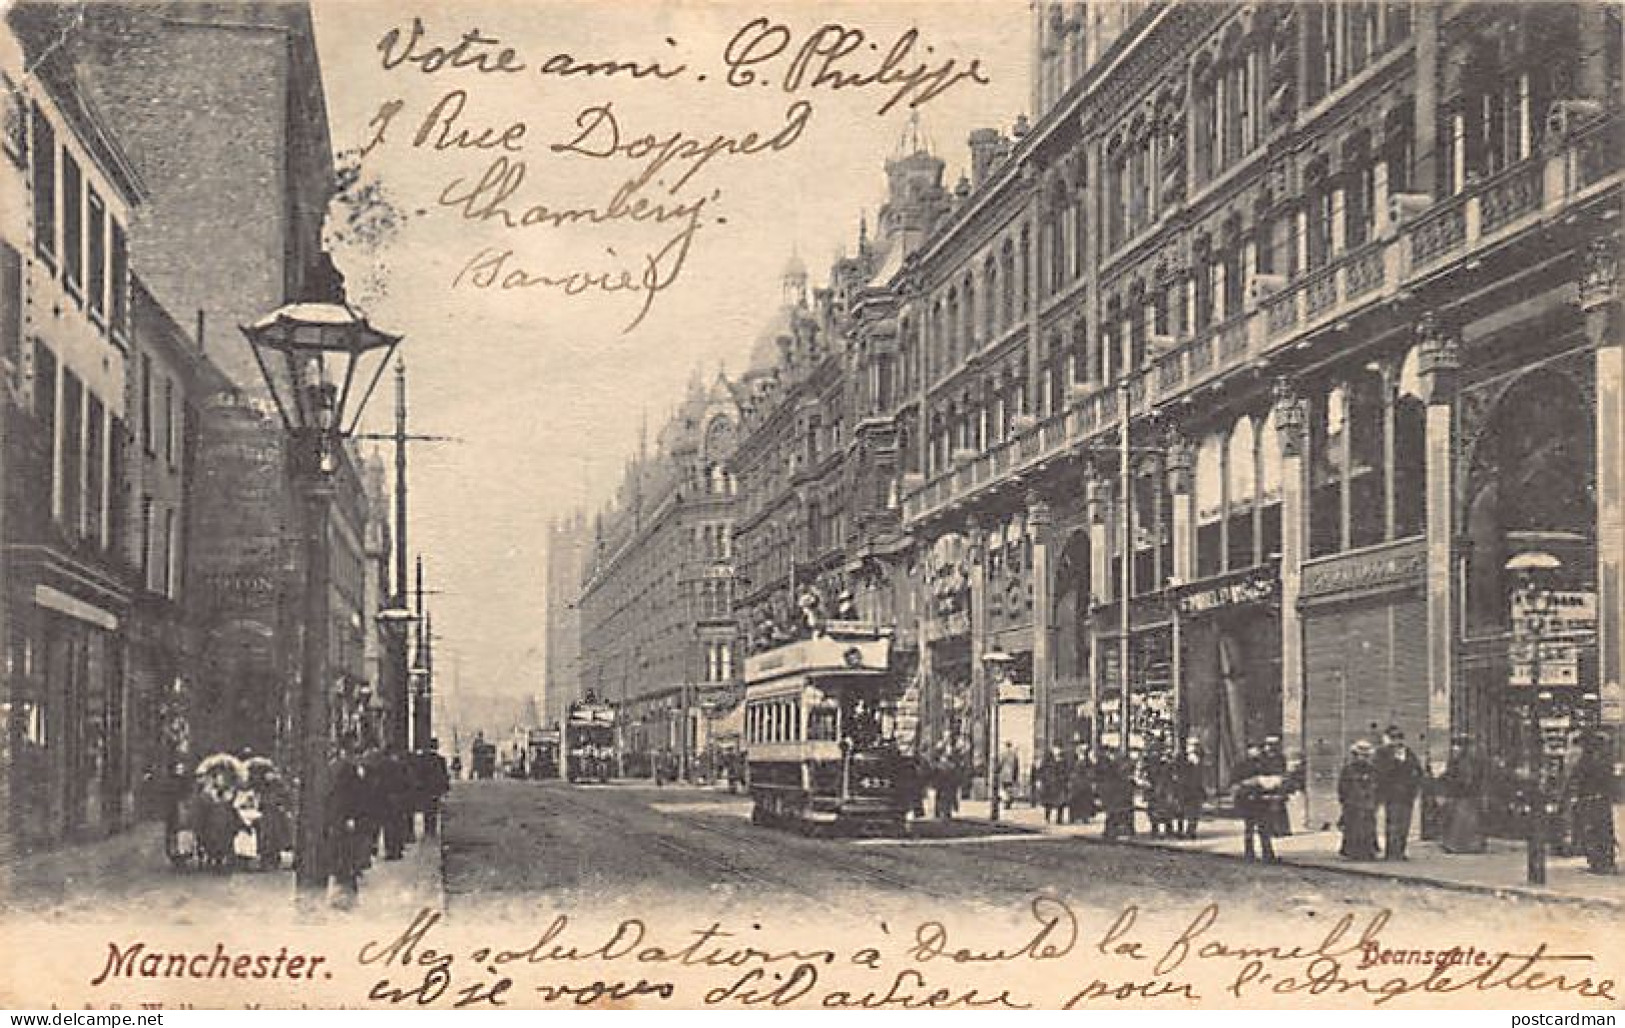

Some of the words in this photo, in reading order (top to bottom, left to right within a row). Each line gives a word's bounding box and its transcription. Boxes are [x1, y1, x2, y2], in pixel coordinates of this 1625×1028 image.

[377, 17, 526, 73] Votre
[783, 24, 990, 115] Philippe
[413, 90, 526, 150] Rue
[358, 907, 453, 967] Mes
[851, 921, 890, 968] à
[1098, 905, 1148, 959] la
[536, 978, 675, 1005] vous
[1062, 979, 1201, 1010] pour
